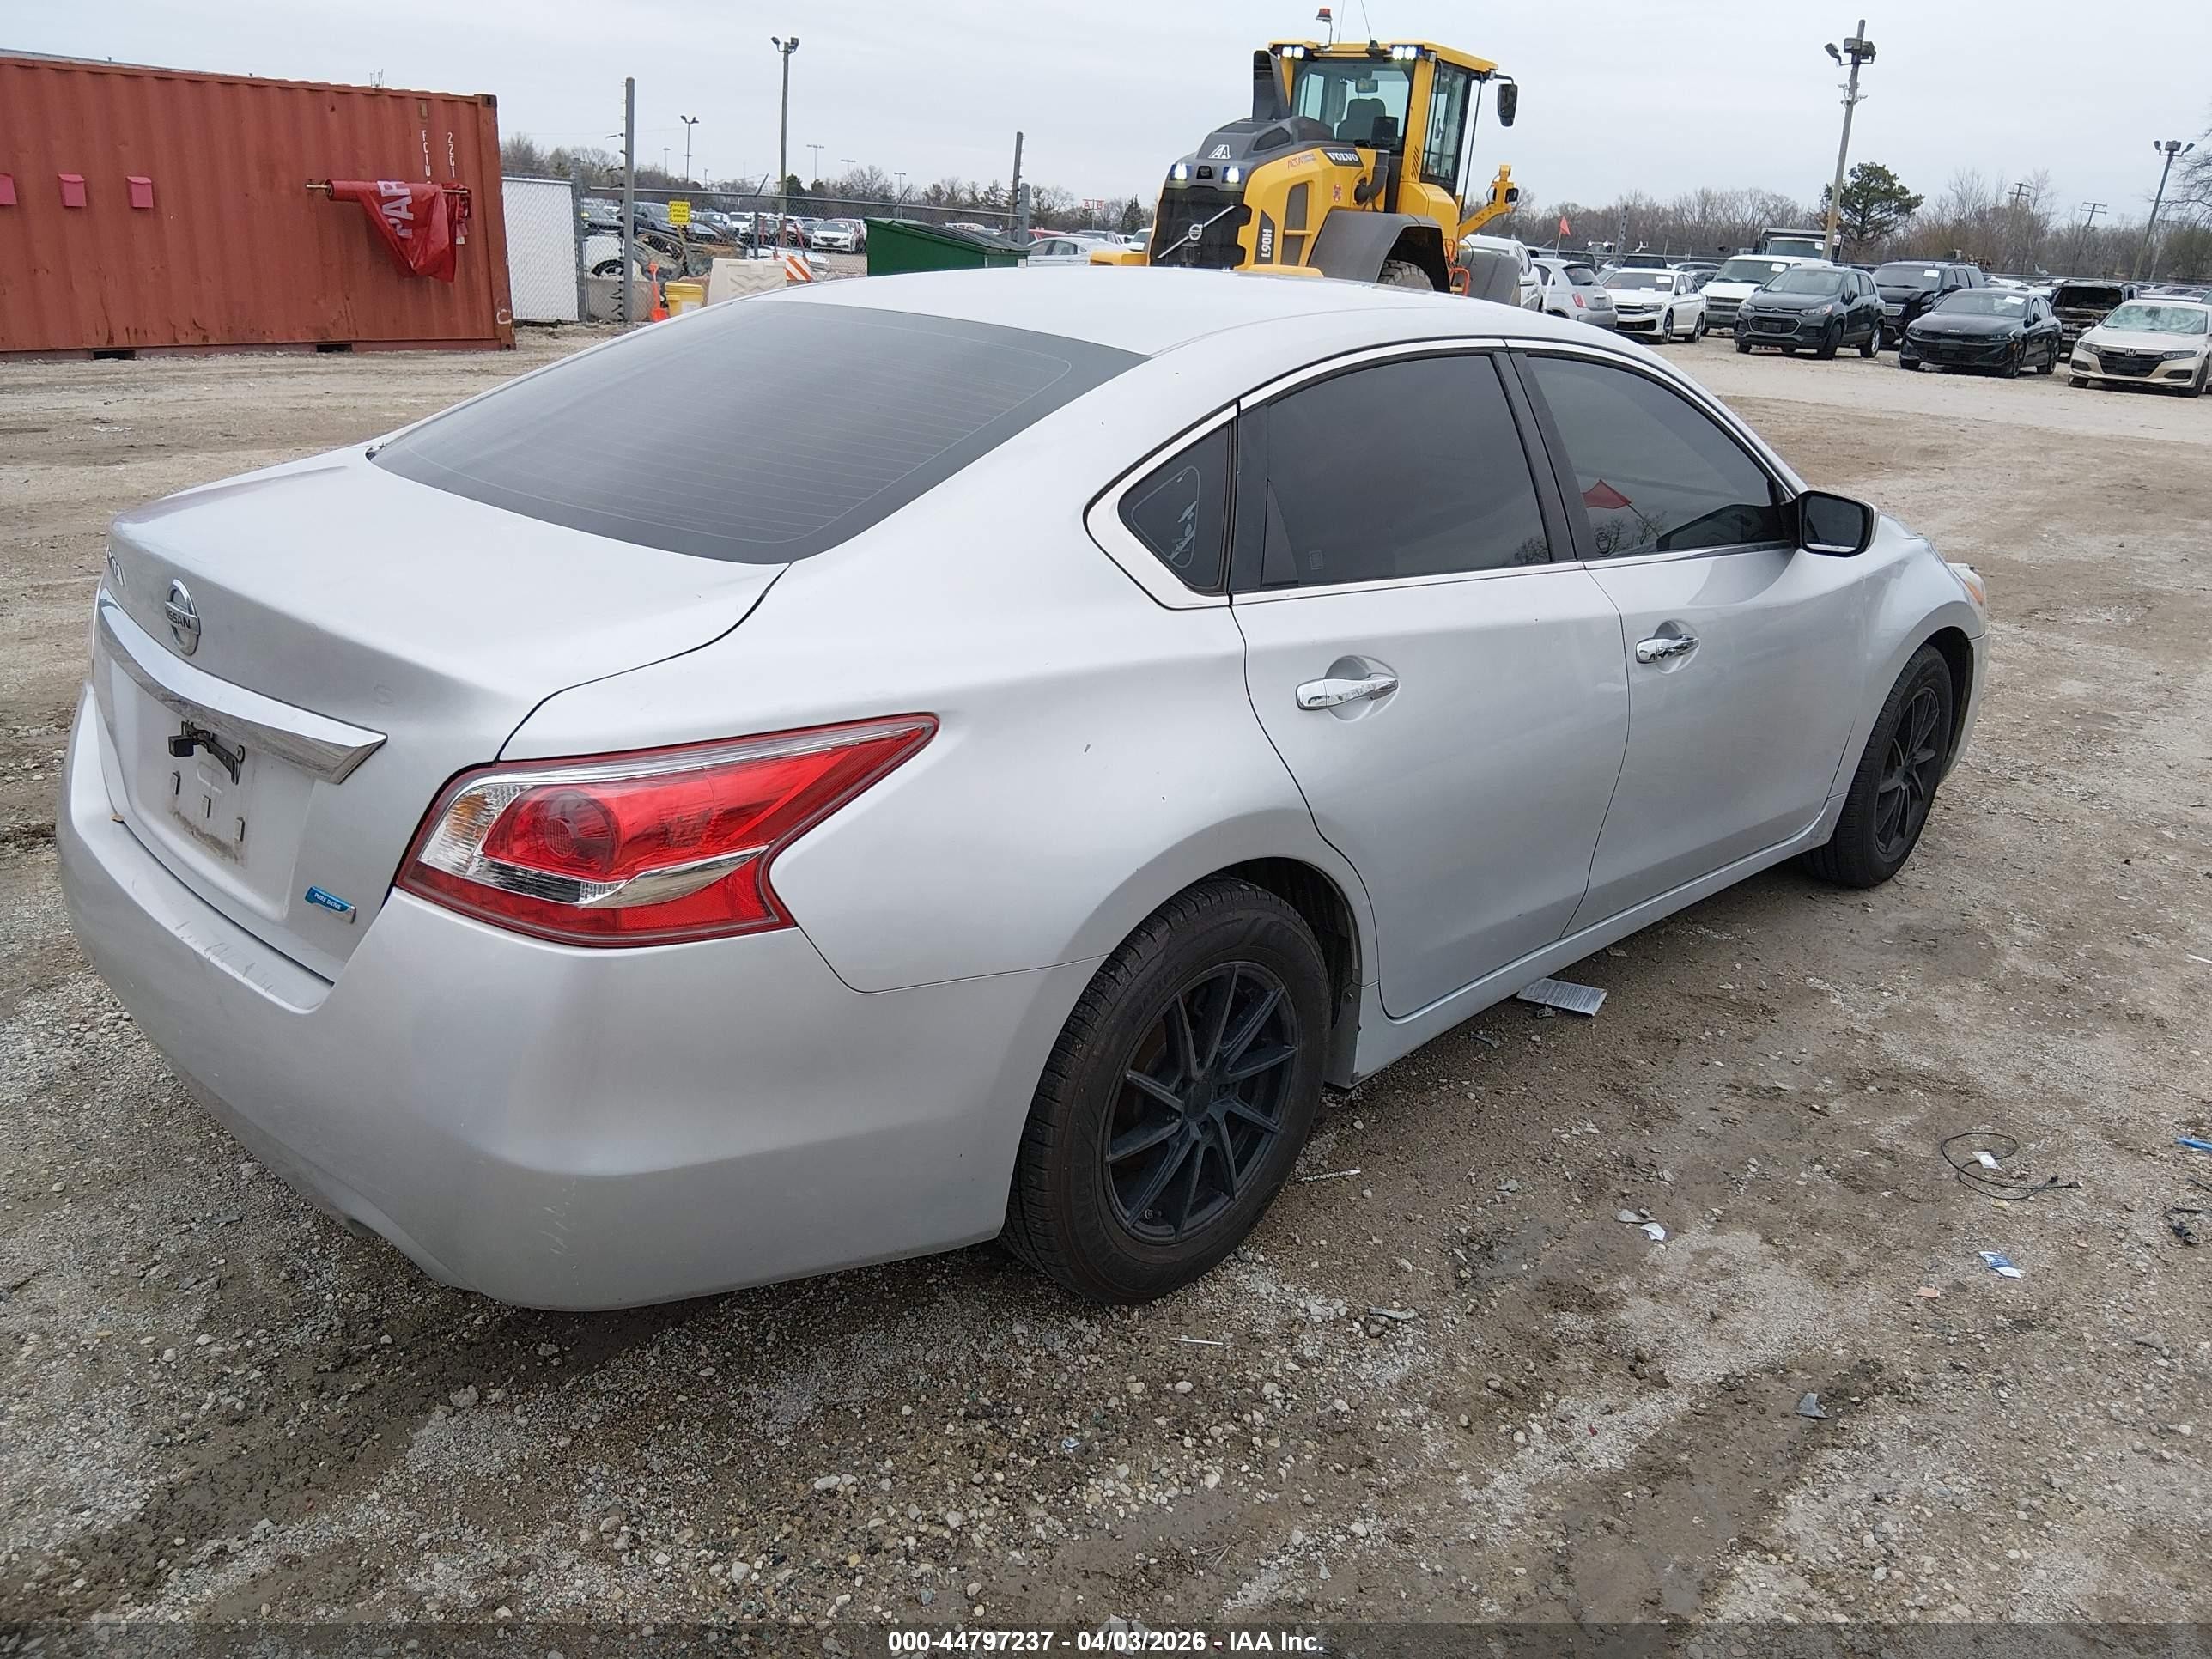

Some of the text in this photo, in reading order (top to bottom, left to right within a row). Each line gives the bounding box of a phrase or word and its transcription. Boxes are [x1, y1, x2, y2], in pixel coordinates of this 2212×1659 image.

[1326, 152, 1358, 162] VOLVO
[1261, 228, 1273, 258] L90H
[313, 892, 342, 910] PURE DRIVE
